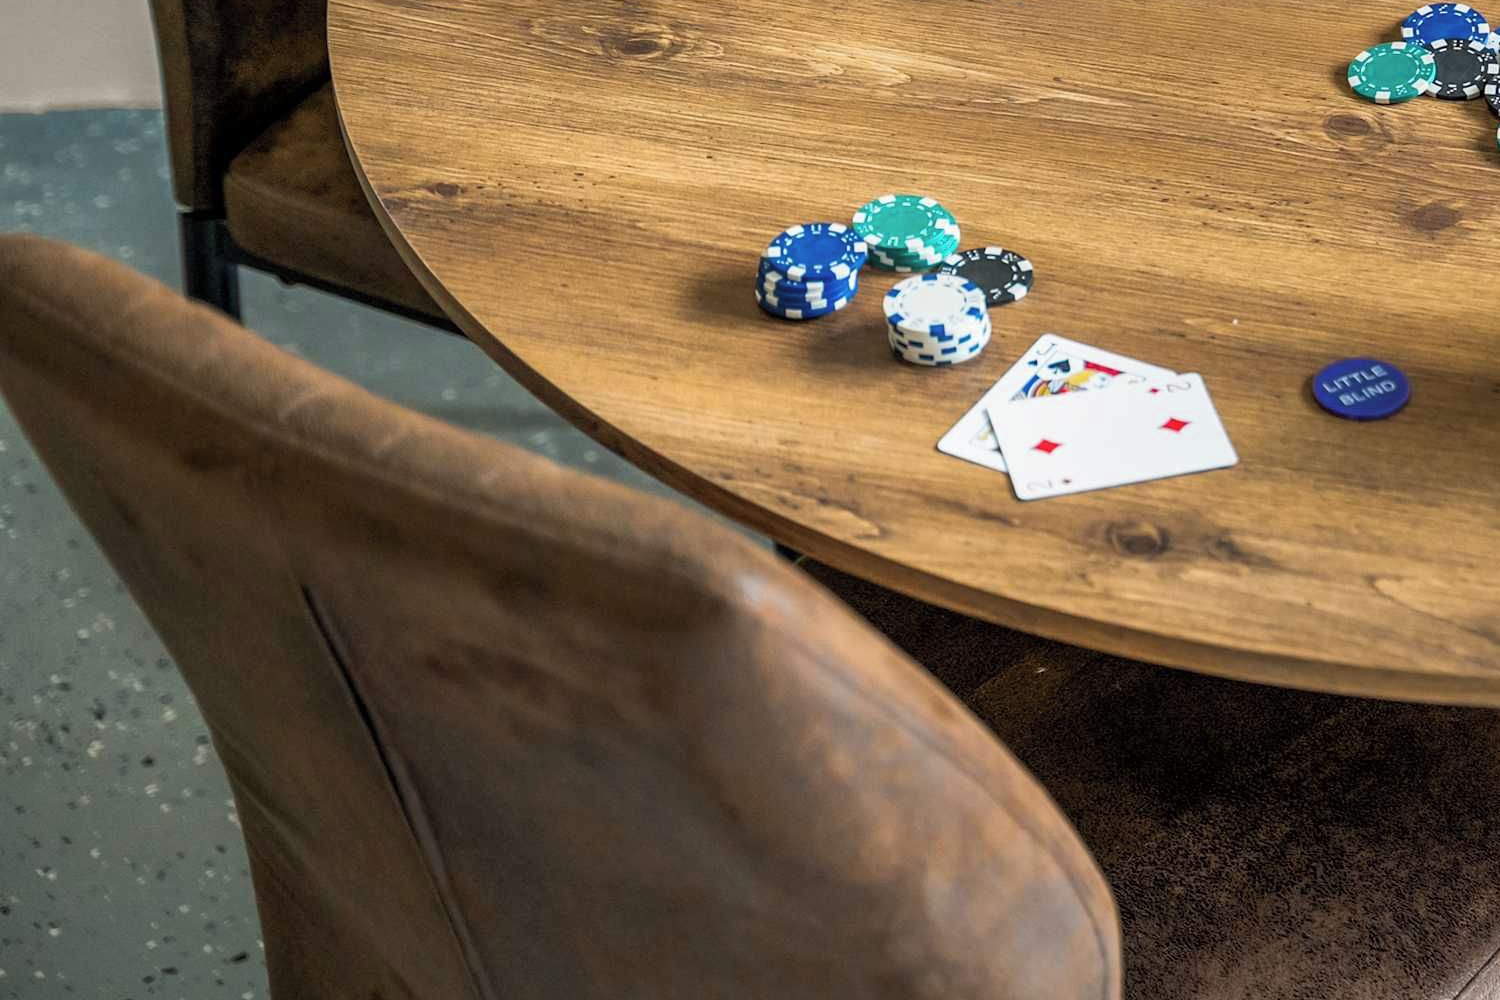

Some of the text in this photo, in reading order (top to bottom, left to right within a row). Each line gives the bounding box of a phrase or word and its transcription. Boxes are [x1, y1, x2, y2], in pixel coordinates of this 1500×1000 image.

[1036, 342, 1057, 355] J
[1166, 379, 1192, 393] 2
[1322, 364, 1388, 393] LITTLE
[1338, 380, 1397, 406] BLIND
